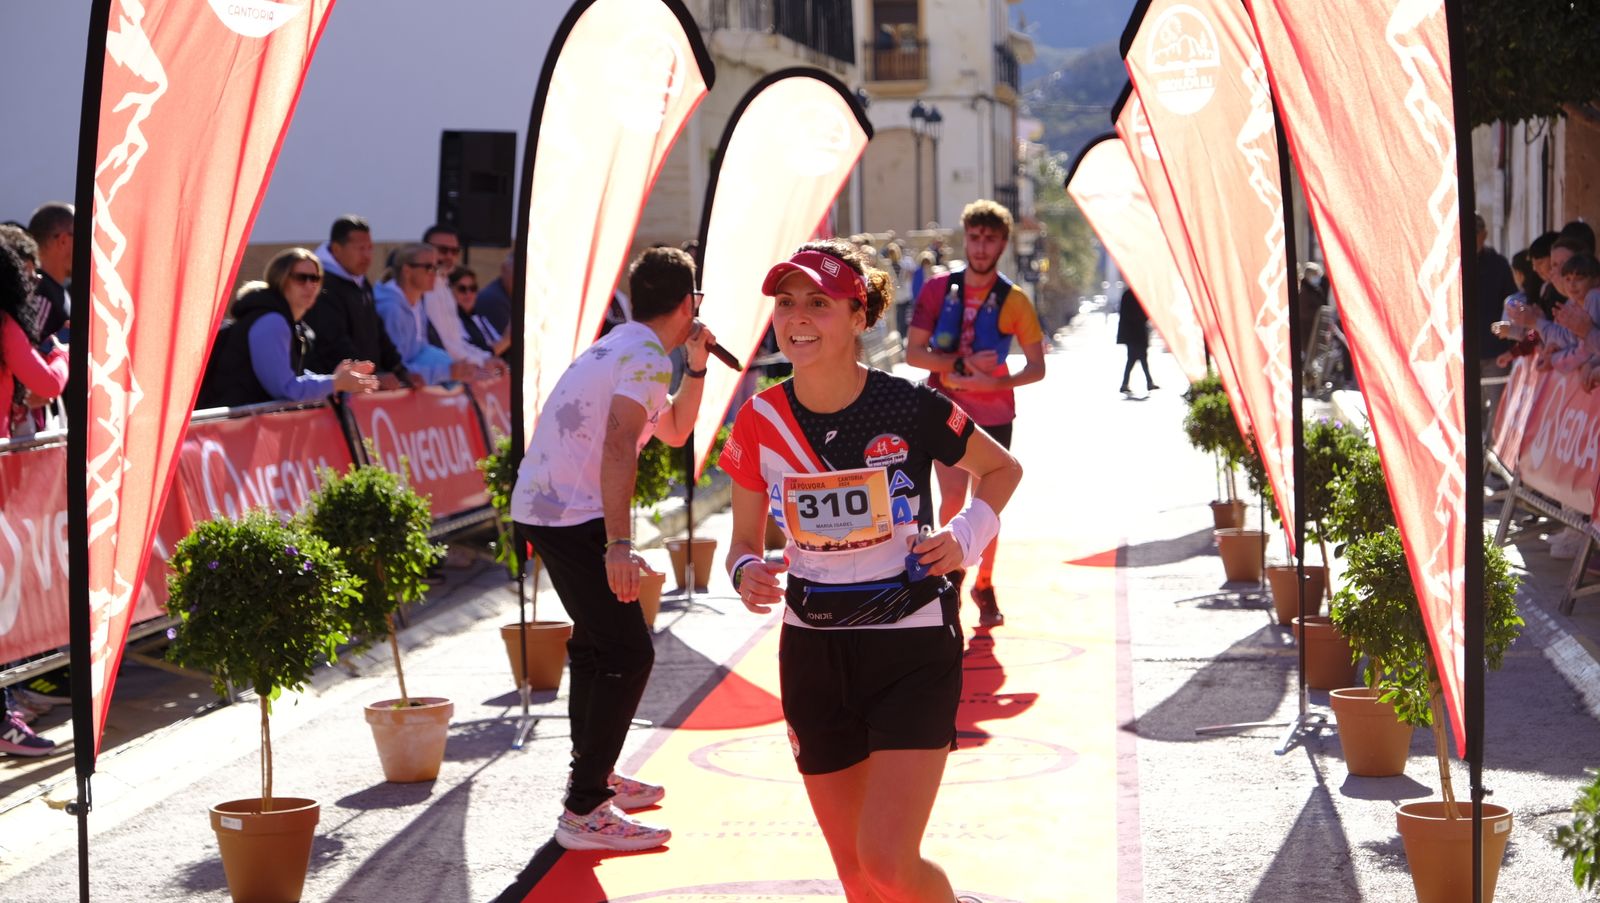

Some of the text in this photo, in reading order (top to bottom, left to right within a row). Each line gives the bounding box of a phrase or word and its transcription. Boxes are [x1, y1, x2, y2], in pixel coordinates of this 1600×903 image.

[227, 4, 274, 21] CANTORIA
[400, 424, 476, 484] VEOLIA
[798, 490, 868, 519] 310
